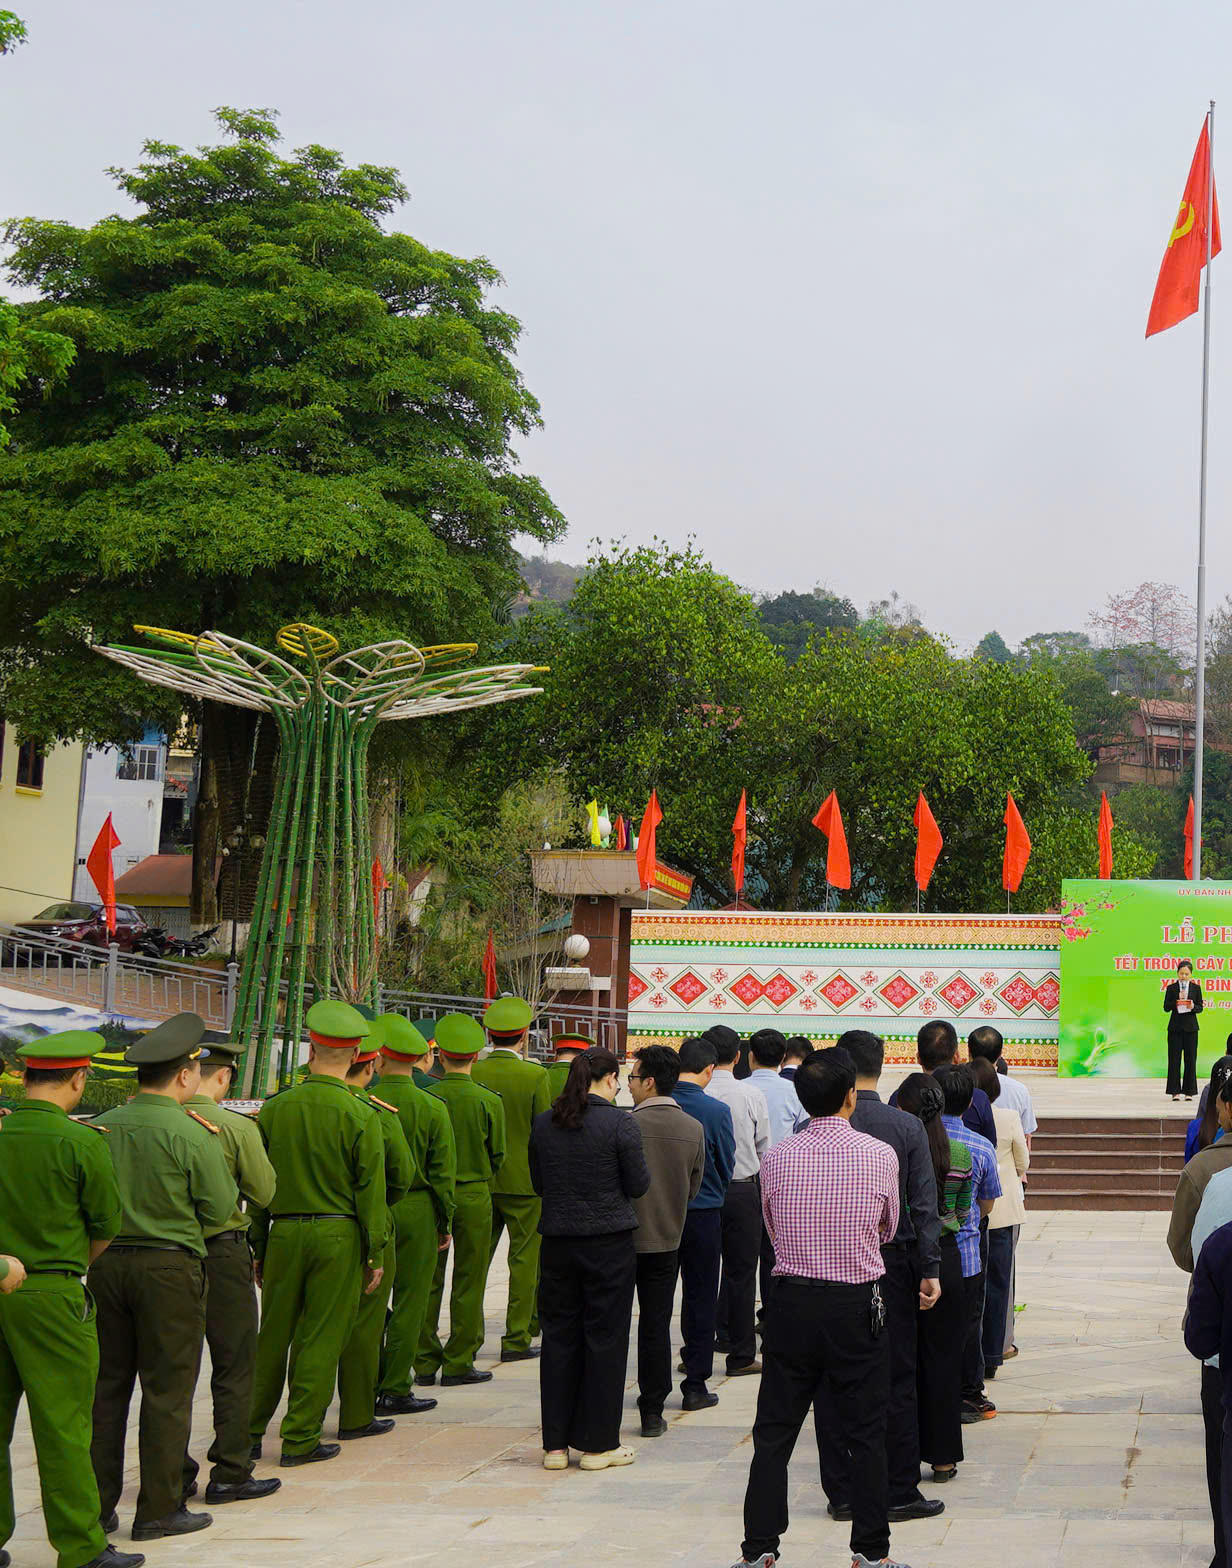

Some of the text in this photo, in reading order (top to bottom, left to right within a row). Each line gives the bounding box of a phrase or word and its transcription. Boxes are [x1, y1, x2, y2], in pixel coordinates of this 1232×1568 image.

[1194, 887, 1215, 896] BAN
[1162, 917, 1194, 944] LỄ
[1114, 953, 1138, 970] TẾT
[1143, 954, 1191, 970] TRỒN
[1196, 955, 1225, 970] CÂY
